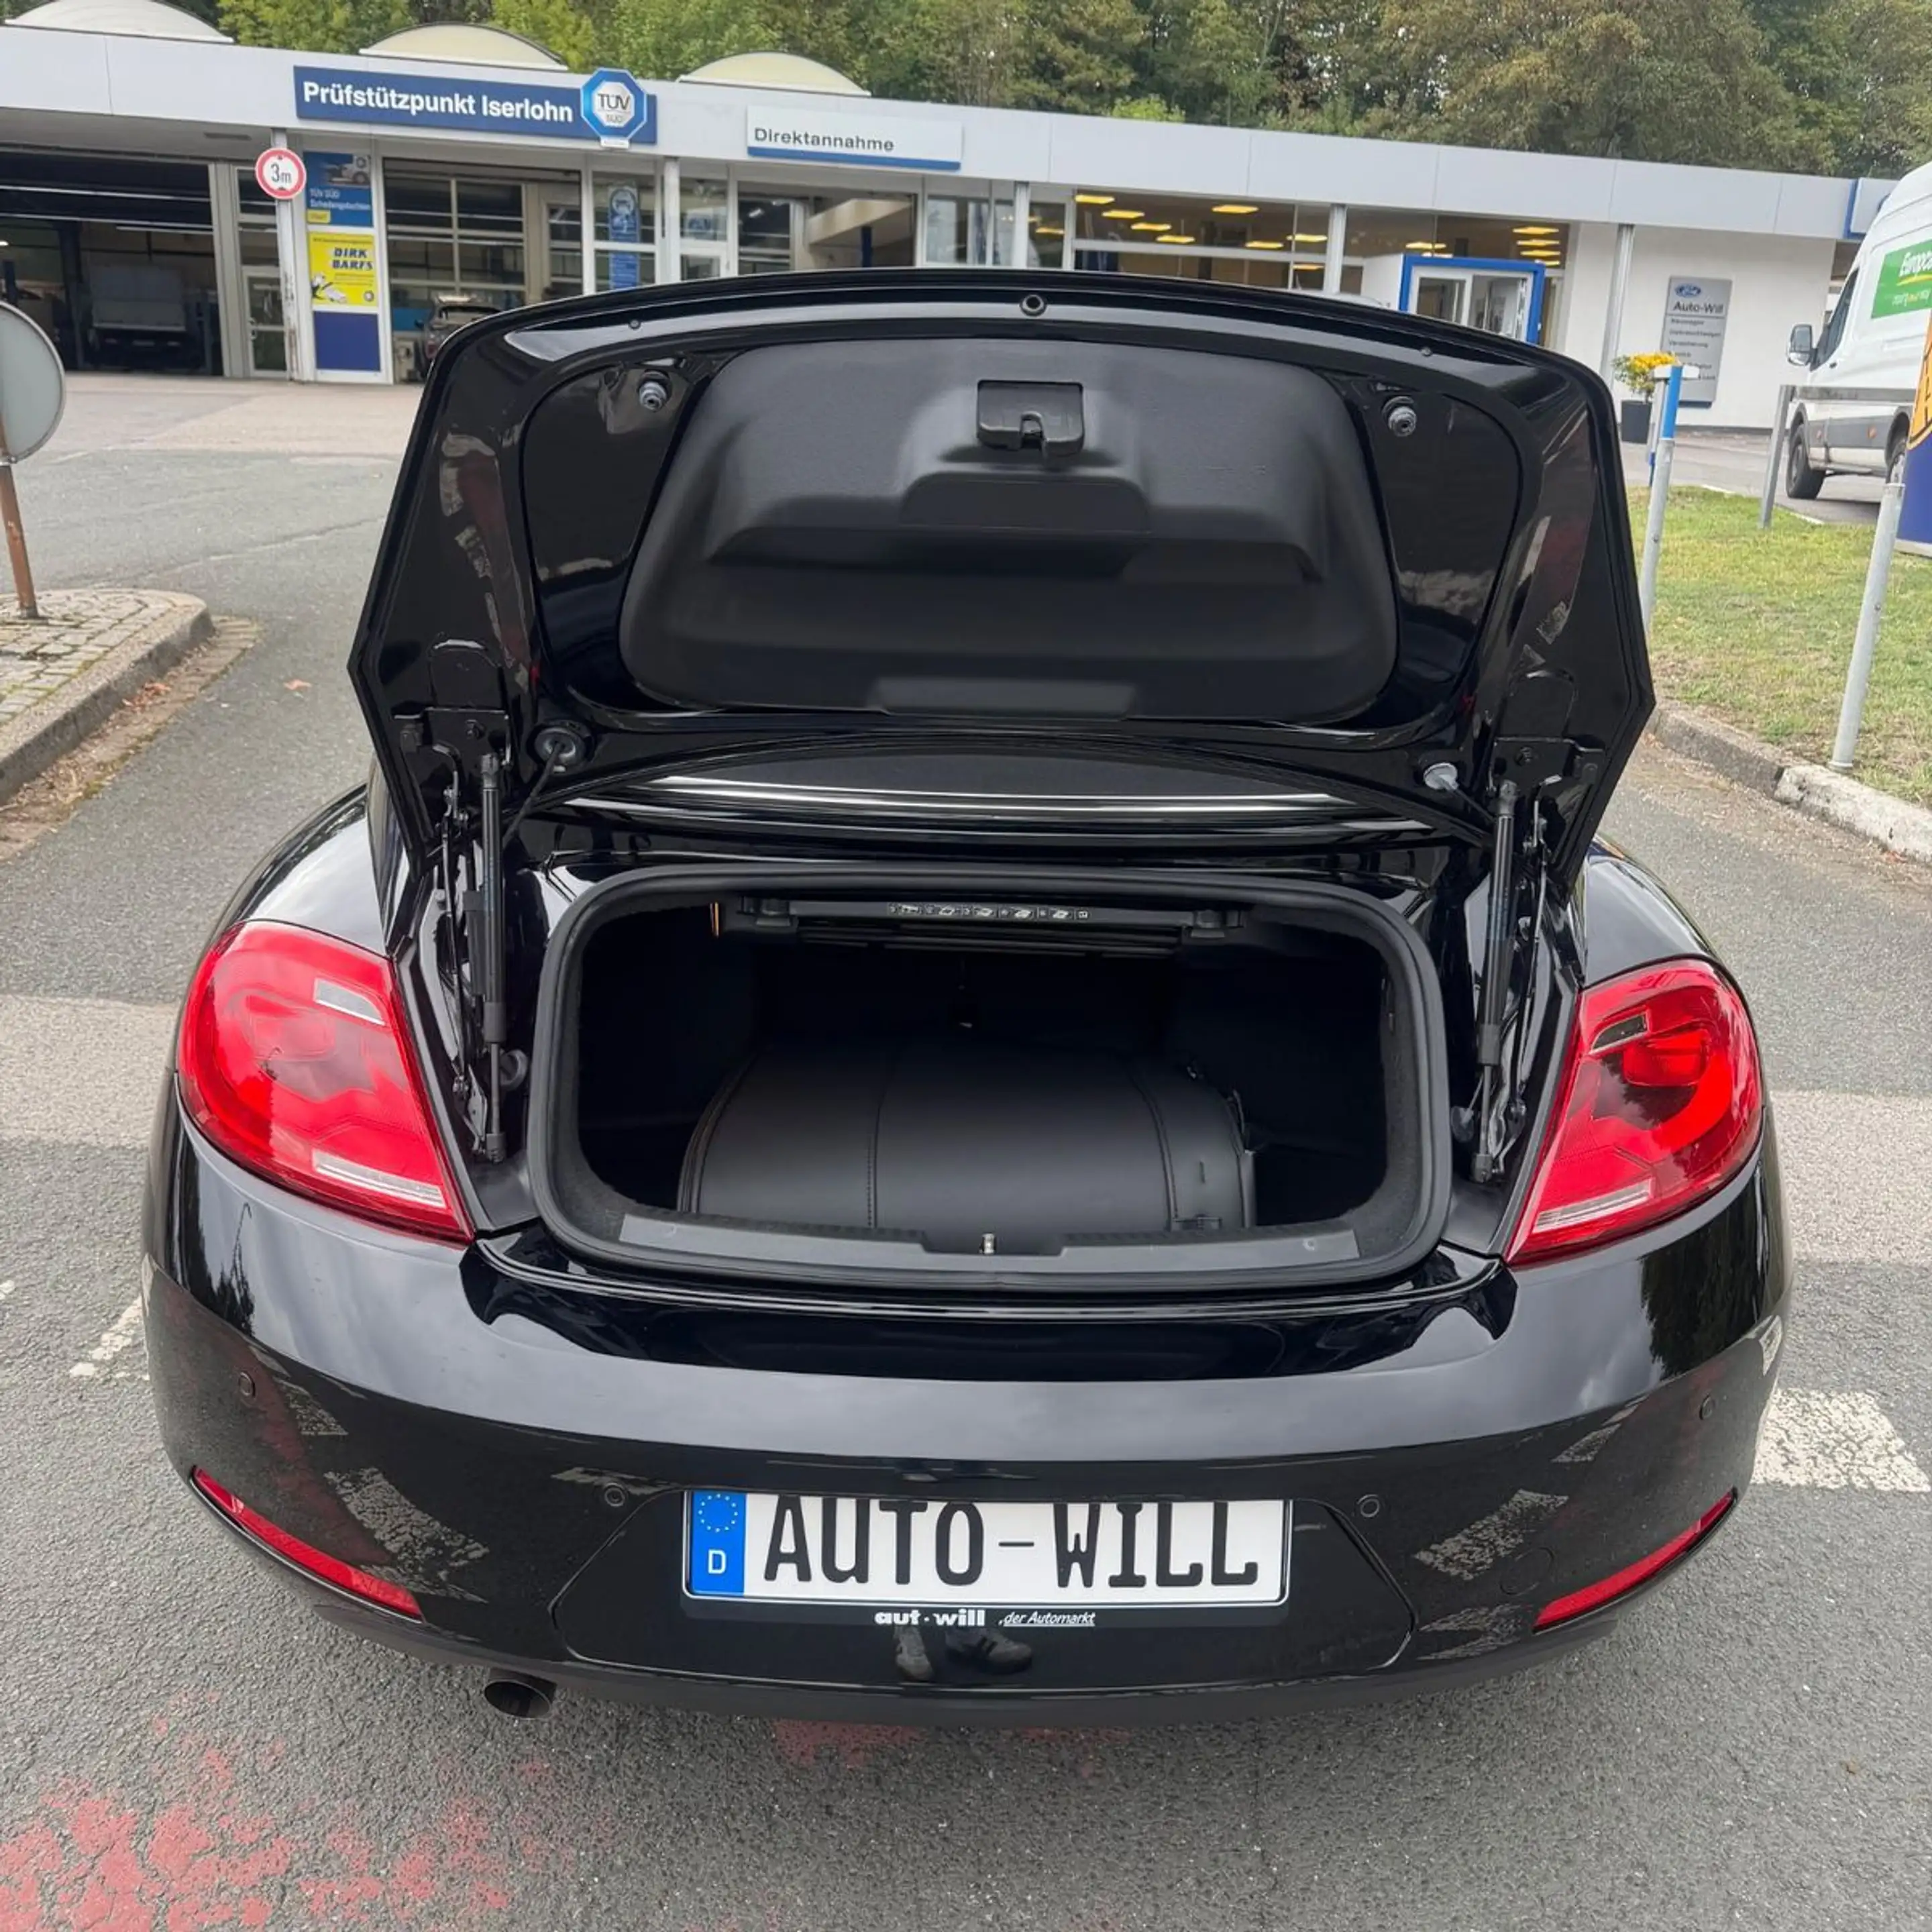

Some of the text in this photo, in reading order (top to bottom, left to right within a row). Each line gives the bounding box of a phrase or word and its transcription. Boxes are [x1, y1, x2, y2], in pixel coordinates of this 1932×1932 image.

[303, 81, 573, 122] Prüfstützpunkt Iserlohn
[598, 93, 631, 110] TÜV
[755, 127, 894, 152] Direktannahme
[1673, 301, 1725, 314] Auto-Will
[708, 1550, 726, 1574] D
